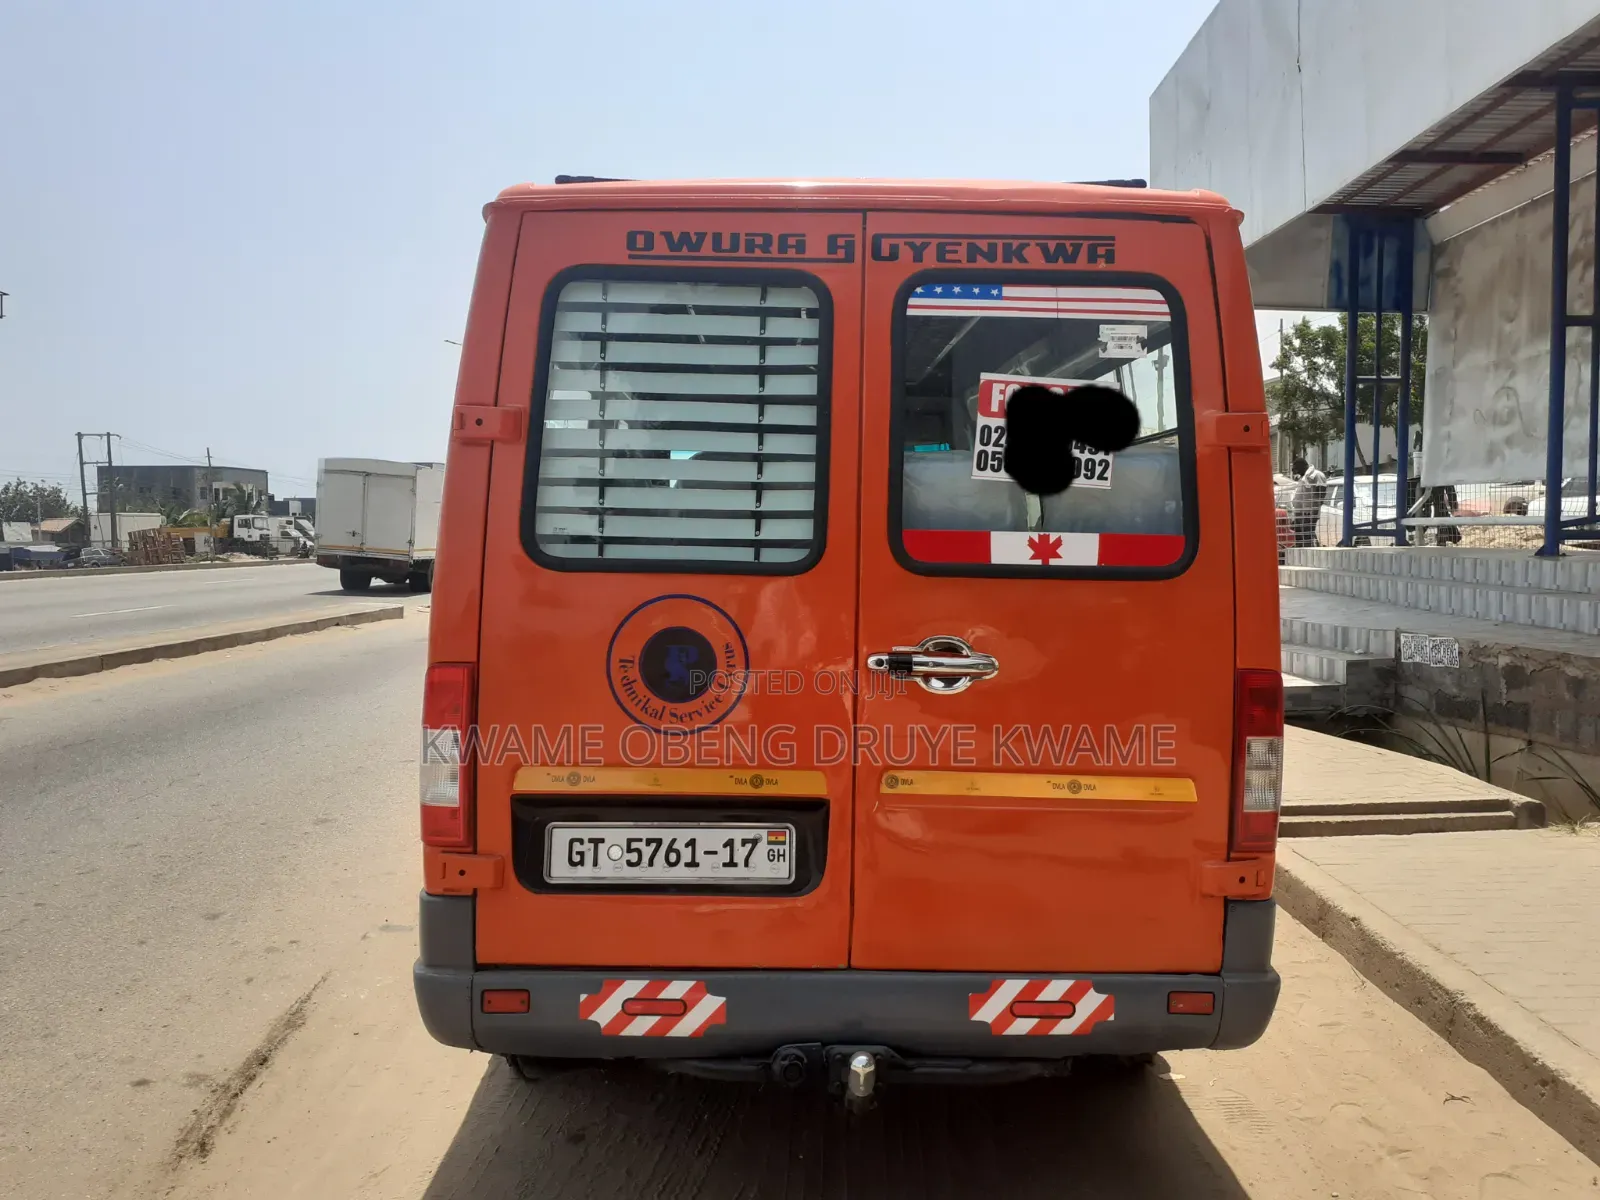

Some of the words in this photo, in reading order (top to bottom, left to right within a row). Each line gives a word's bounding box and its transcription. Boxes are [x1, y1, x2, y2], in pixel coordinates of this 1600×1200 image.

[668, 693, 725, 724] Service
[734, 777, 748, 786] DVLA
[765, 777, 779, 786] DVLA
[900, 777, 914, 786] DVLA
[1052, 782, 1066, 790] DVLA
[567, 837, 606, 868] GT
[625, 837, 762, 868] 5761-17
[767, 848, 786, 863] GH
